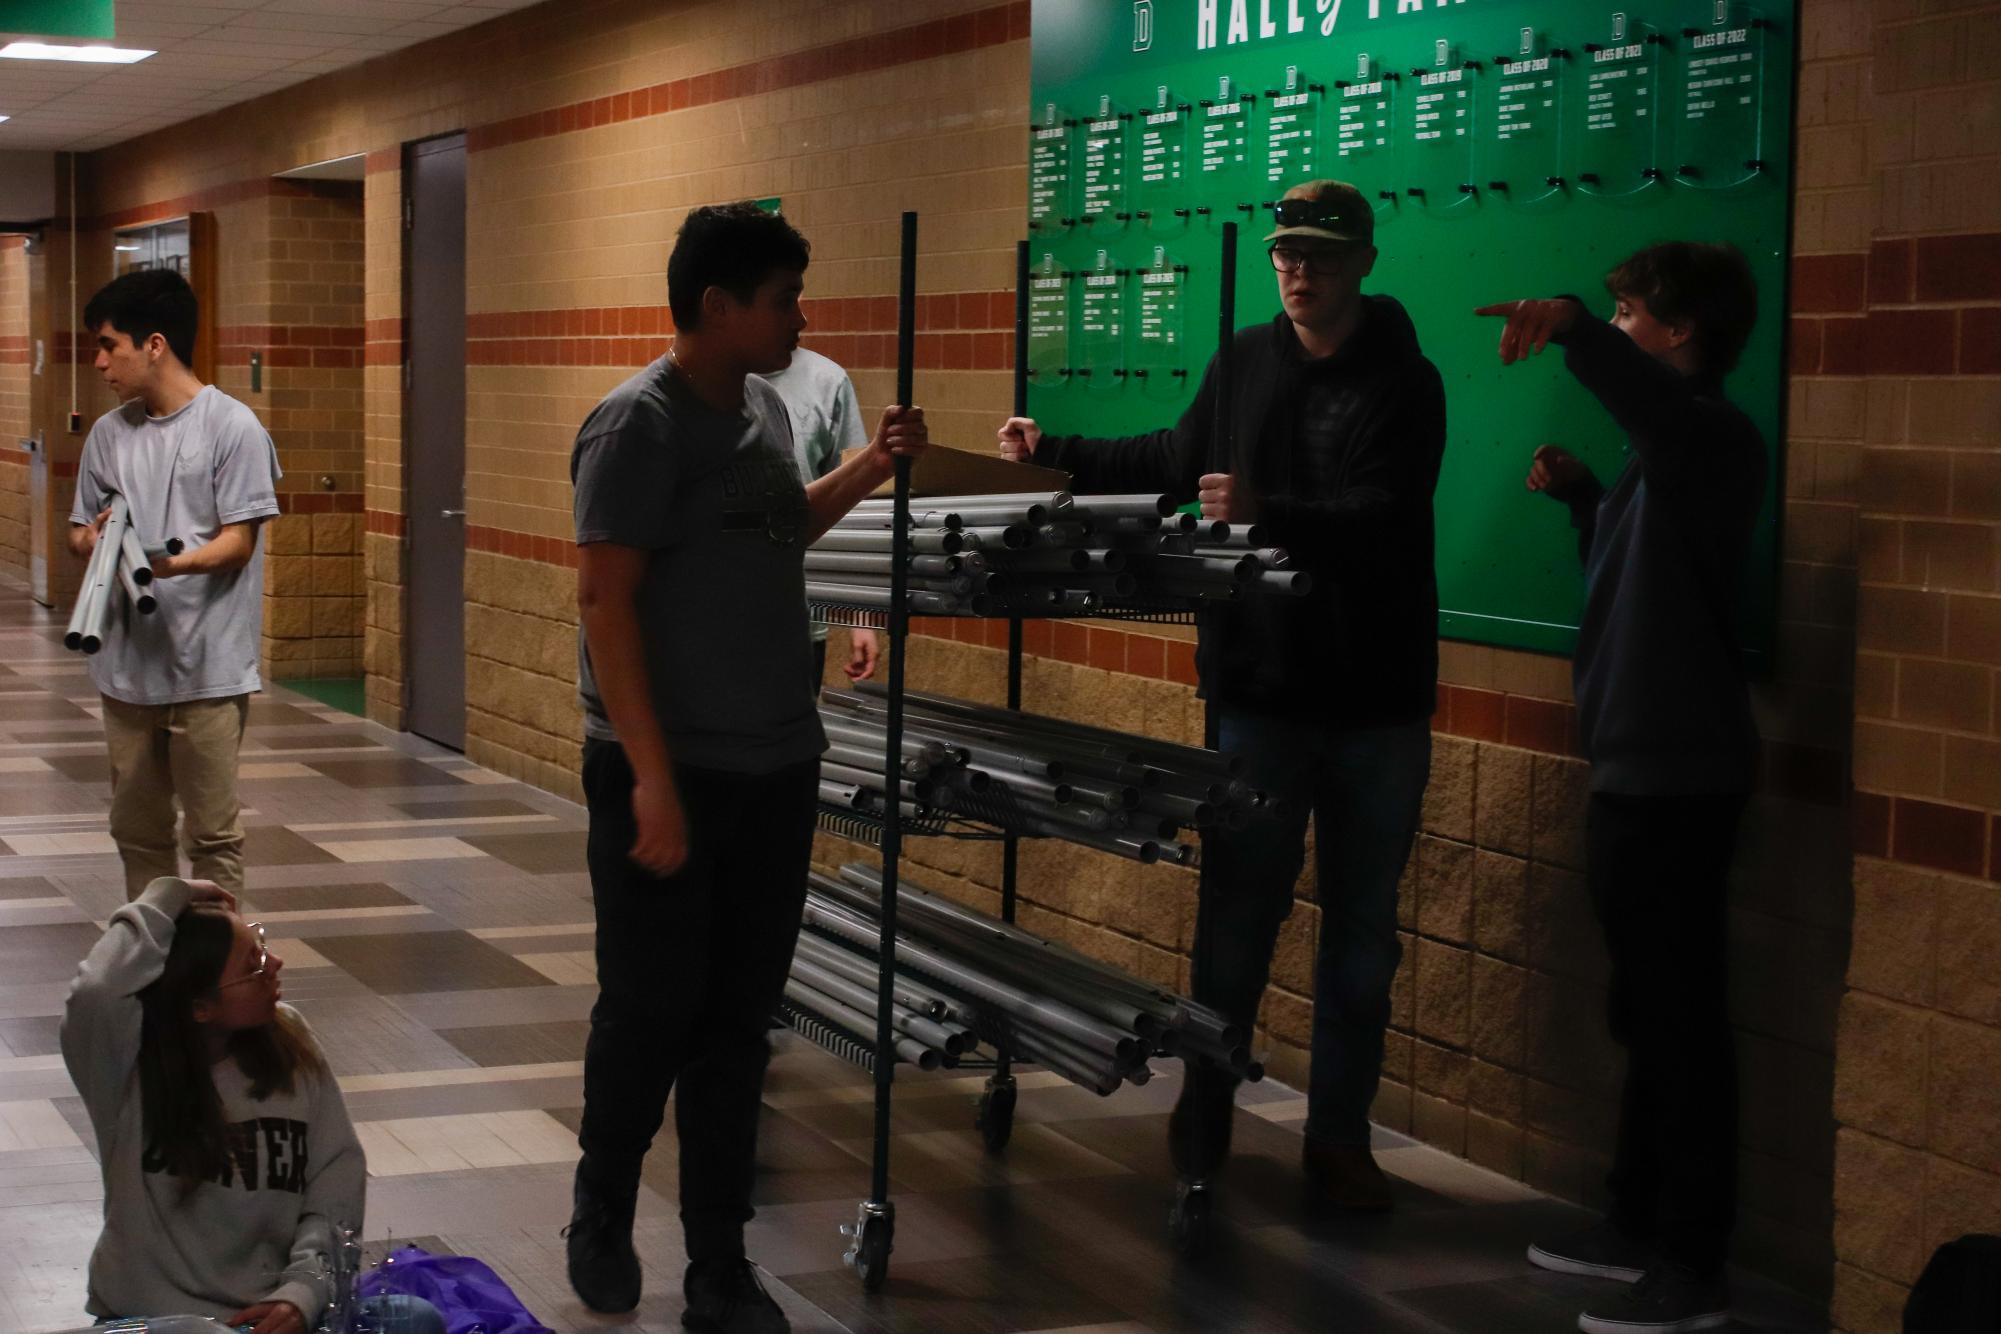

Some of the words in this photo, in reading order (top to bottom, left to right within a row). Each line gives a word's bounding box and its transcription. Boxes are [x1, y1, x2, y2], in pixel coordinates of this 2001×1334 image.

[1693, 34, 1715, 48] CLASS
[1716, 32, 1726, 45] OF
[1727, 29, 1746, 43] 2022
[1594, 48, 1615, 62] CLASS
